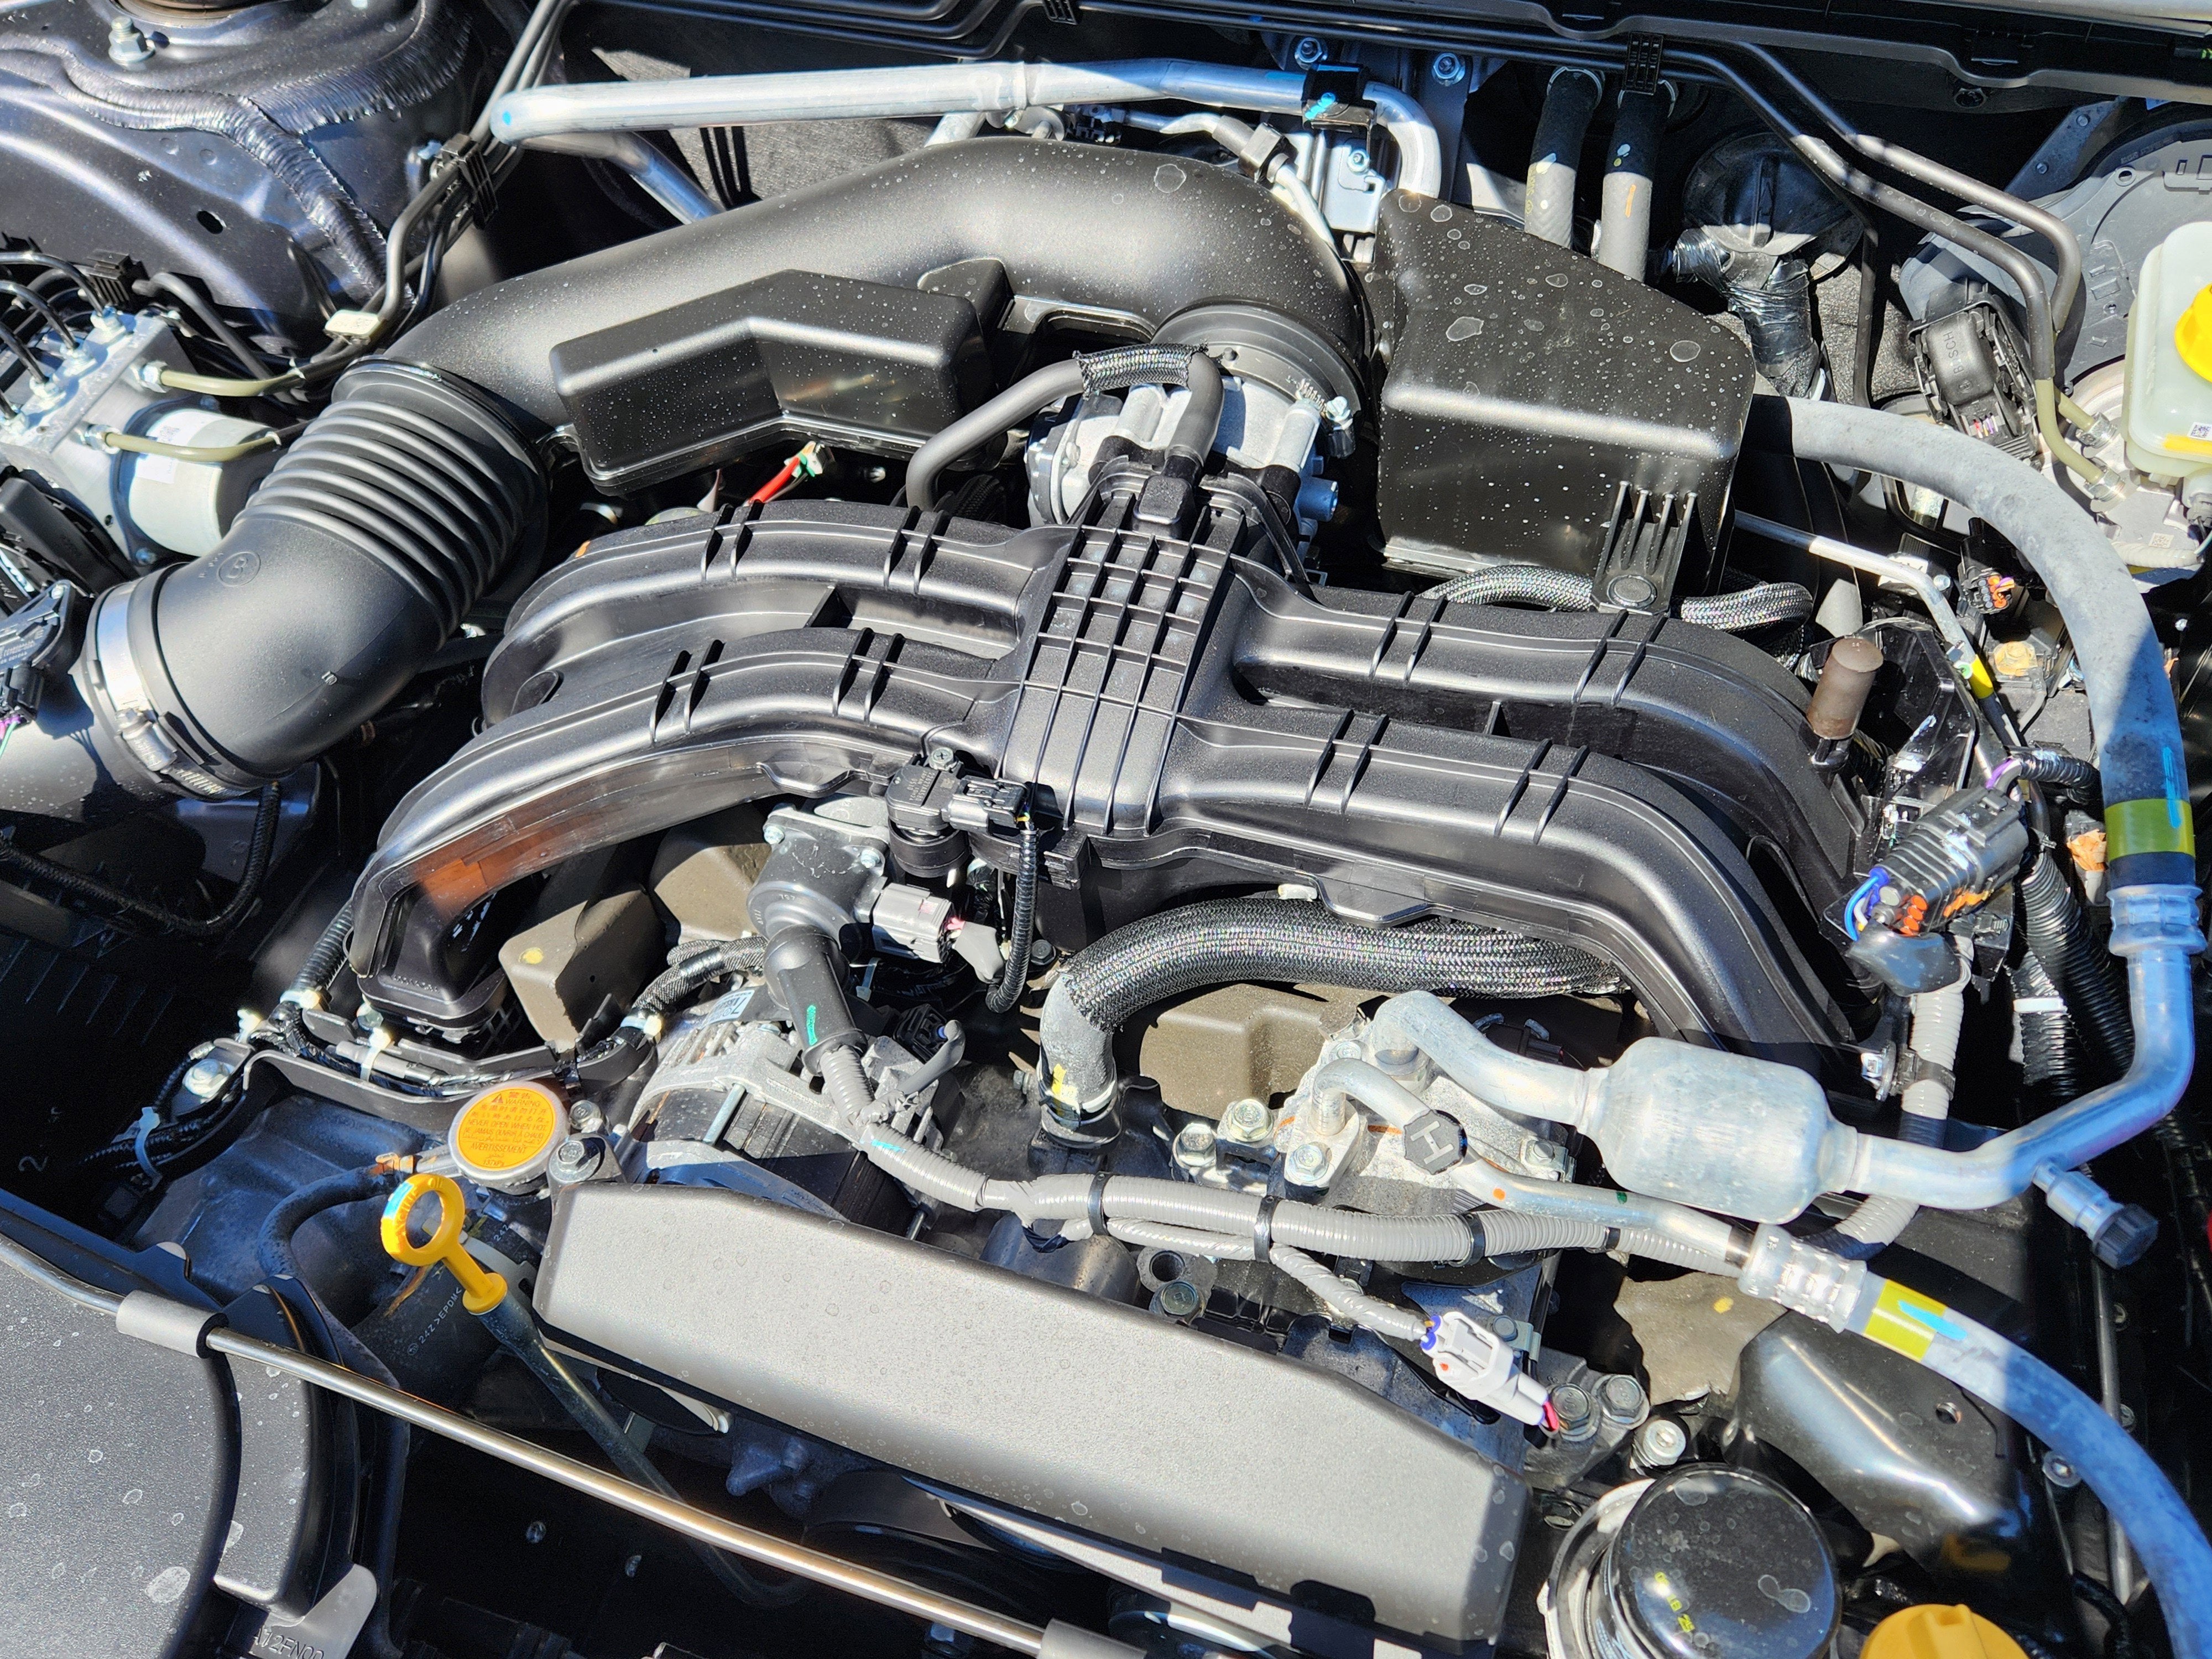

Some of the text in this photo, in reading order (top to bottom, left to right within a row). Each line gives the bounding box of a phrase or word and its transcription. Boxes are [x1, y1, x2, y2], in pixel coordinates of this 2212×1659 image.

[505, 1099, 541, 1107] WARNING
[471, 1142, 527, 1154] AVERTISSEMENT
[1410, 1120, 1454, 1165] H
[434, 1286, 462, 1325] >EPDM<
